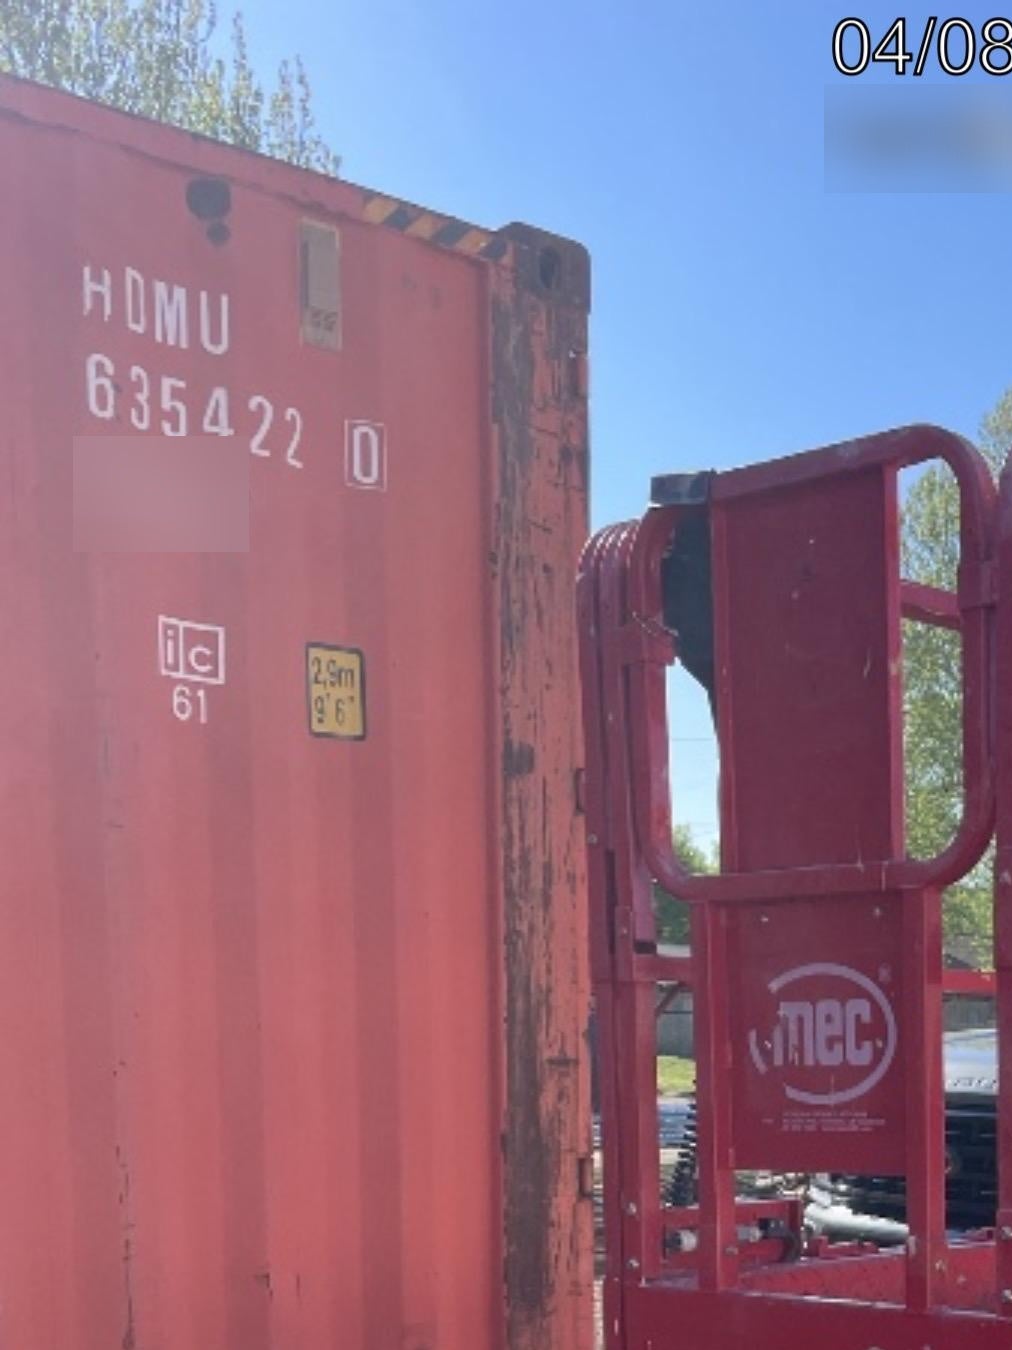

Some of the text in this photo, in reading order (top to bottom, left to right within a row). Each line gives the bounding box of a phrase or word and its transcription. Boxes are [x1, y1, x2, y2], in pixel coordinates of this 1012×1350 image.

[83, 265, 230, 355] HDMU
[85, 353, 305, 469] 635422
[171, 683, 208, 724] 61
